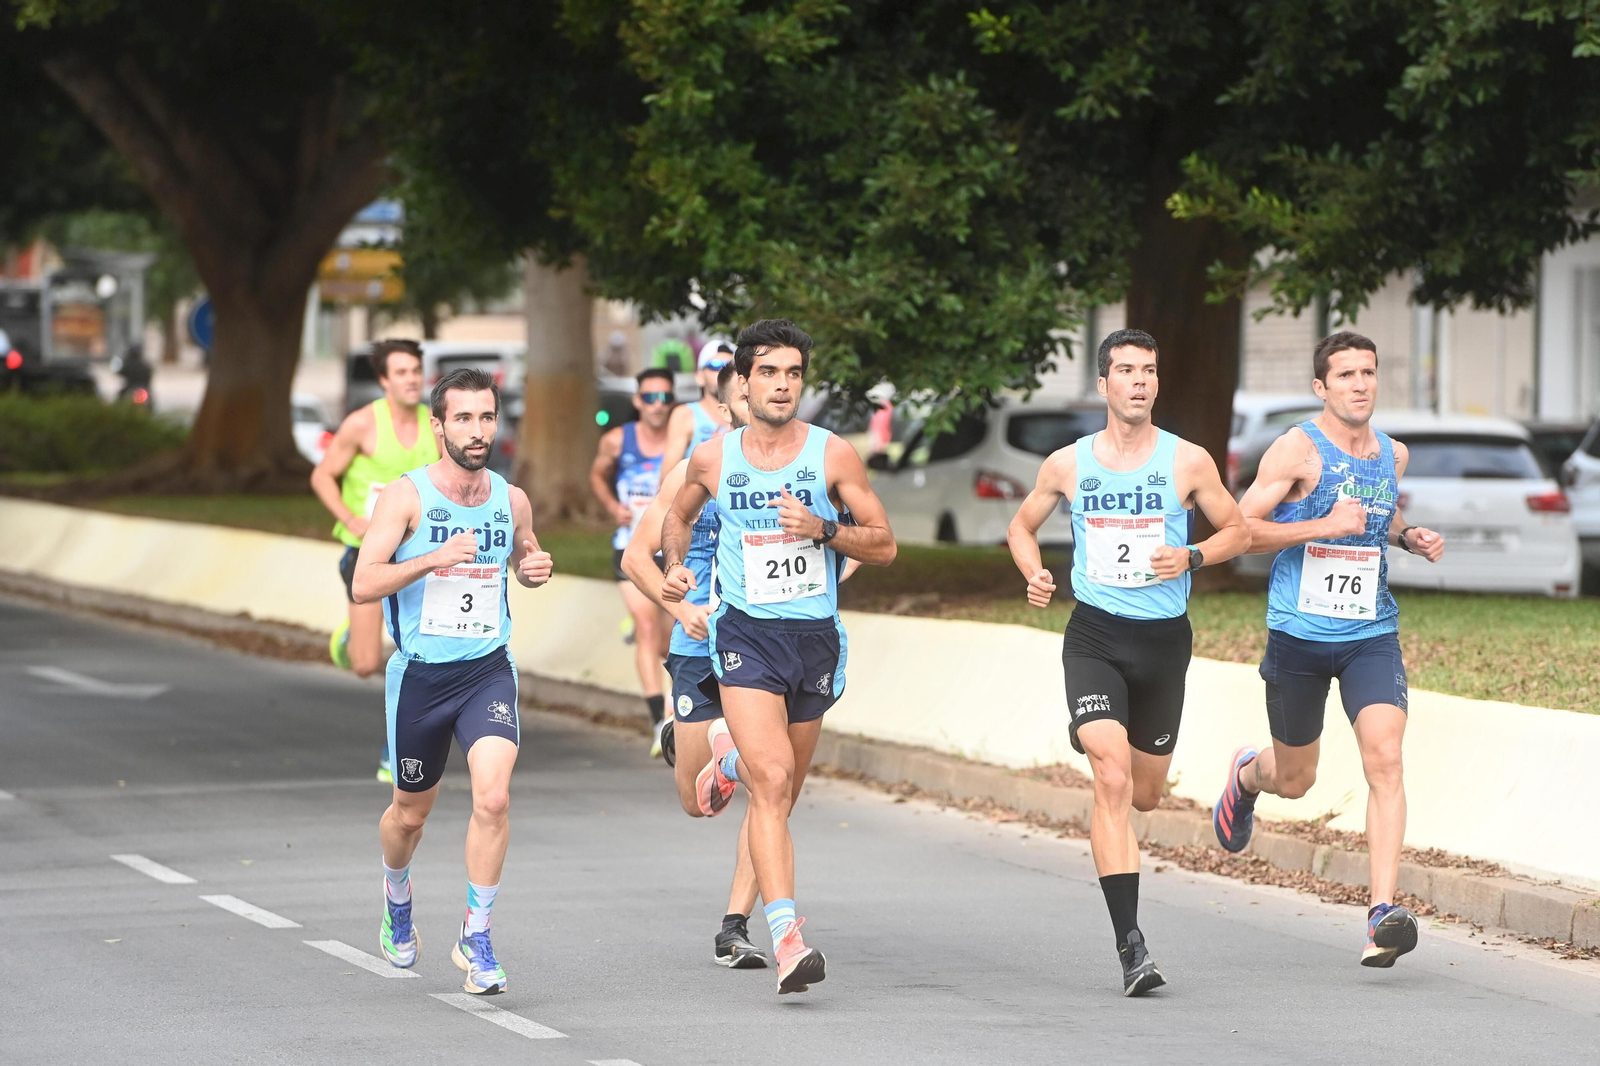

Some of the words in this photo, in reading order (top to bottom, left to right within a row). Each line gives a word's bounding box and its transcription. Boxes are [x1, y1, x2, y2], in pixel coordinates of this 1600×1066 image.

[727, 475, 749, 486] TROPS
[1081, 479, 1101, 490] TROPS
[729, 482, 813, 510] nera
[1082, 485, 1164, 515] nerja
[428, 509, 451, 520] TROPS
[745, 518, 783, 529] ATLET
[1086, 517, 1105, 529] 42
[744, 534, 763, 547] 42
[1117, 543, 1130, 563] 2
[1307, 545, 1327, 559] 42
[1327, 548, 1357, 556] CARRERA
[766, 555, 807, 579] 210
[1324, 573, 1362, 595] 176
[460, 593, 474, 613] 3
[1079, 704, 1111, 714] BEAST
